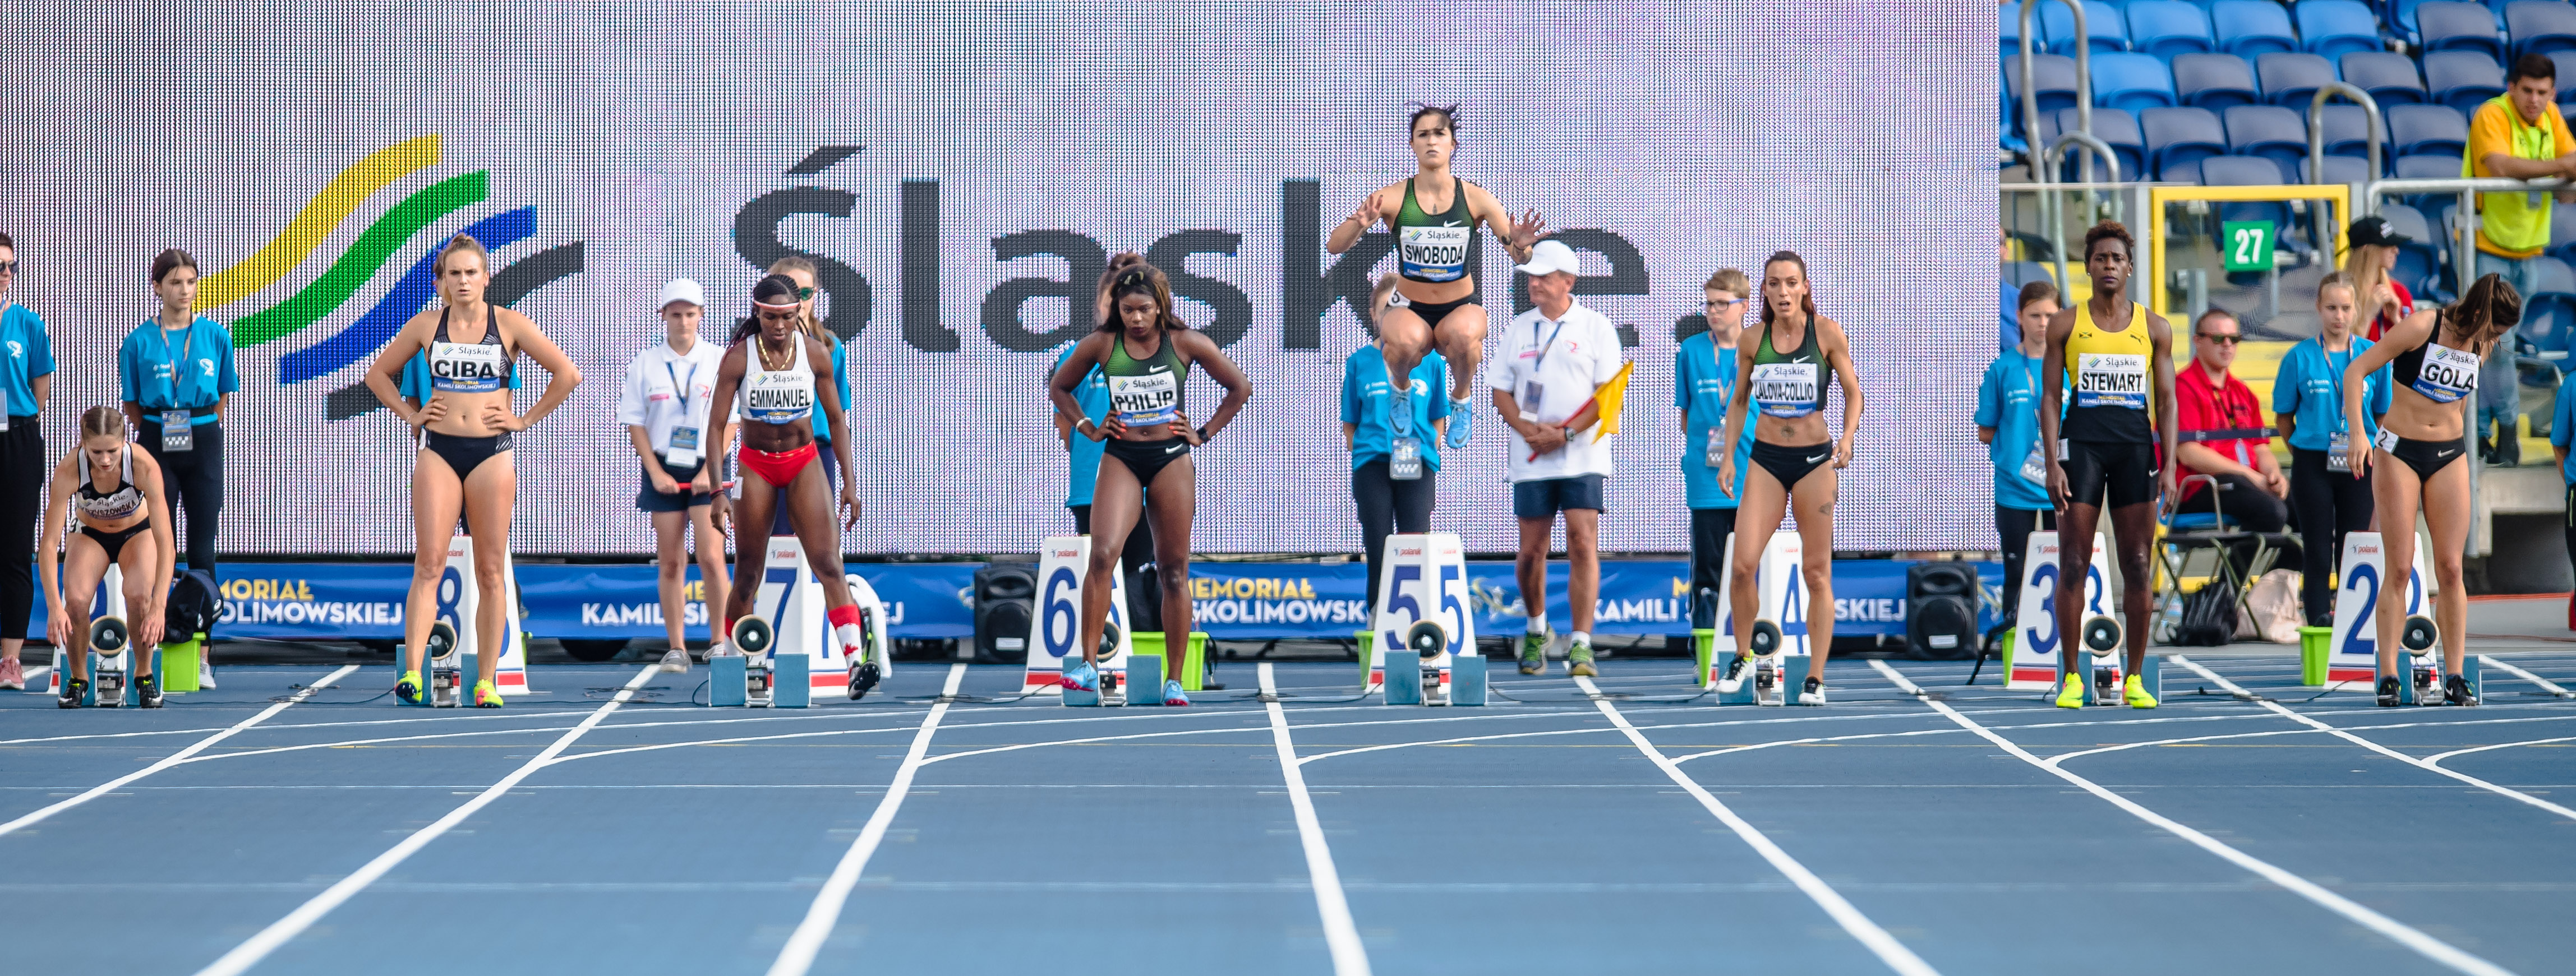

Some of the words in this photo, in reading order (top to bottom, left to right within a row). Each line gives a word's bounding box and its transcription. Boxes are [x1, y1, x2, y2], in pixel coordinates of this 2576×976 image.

[1427, 229, 1462, 240] Śląskie.
[1405, 245, 1463, 264] SWOBODA
[2234, 228, 2264, 263] 27
[459, 345, 492, 355] Śląskie.
[2450, 351, 2476, 365] Śląskie.
[434, 359, 495, 378] CIBA
[1774, 365, 1808, 377] Śląskie.
[2106, 356, 2139, 367] Śląskie.
[1133, 379, 1168, 388] Śląskie.
[2081, 371, 2142, 391] STEWART
[2425, 363, 2474, 390] GOLA
[750, 389, 810, 408] EMMANUEL
[1114, 390, 1173, 412] PHILIP
[1754, 382, 1813, 401] LALOVA-COLLIO
[2378, 430, 2388, 447] 2
[70, 517, 79, 533] 9
[2358, 542, 2378, 554] polanik
[218, 601, 403, 625] OLIMOWSKIEJ
[436, 565, 463, 646] 8
[582, 603, 666, 626] KAMIL
[766, 567, 798, 659] 7
[1043, 566, 1077, 658] 6
[1385, 564, 1421, 650] 5
[1440, 565, 1464, 655] 5
[1780, 563, 1808, 655] 4
[2026, 562, 2059, 654] 3
[2341, 562, 2379, 655] 2
